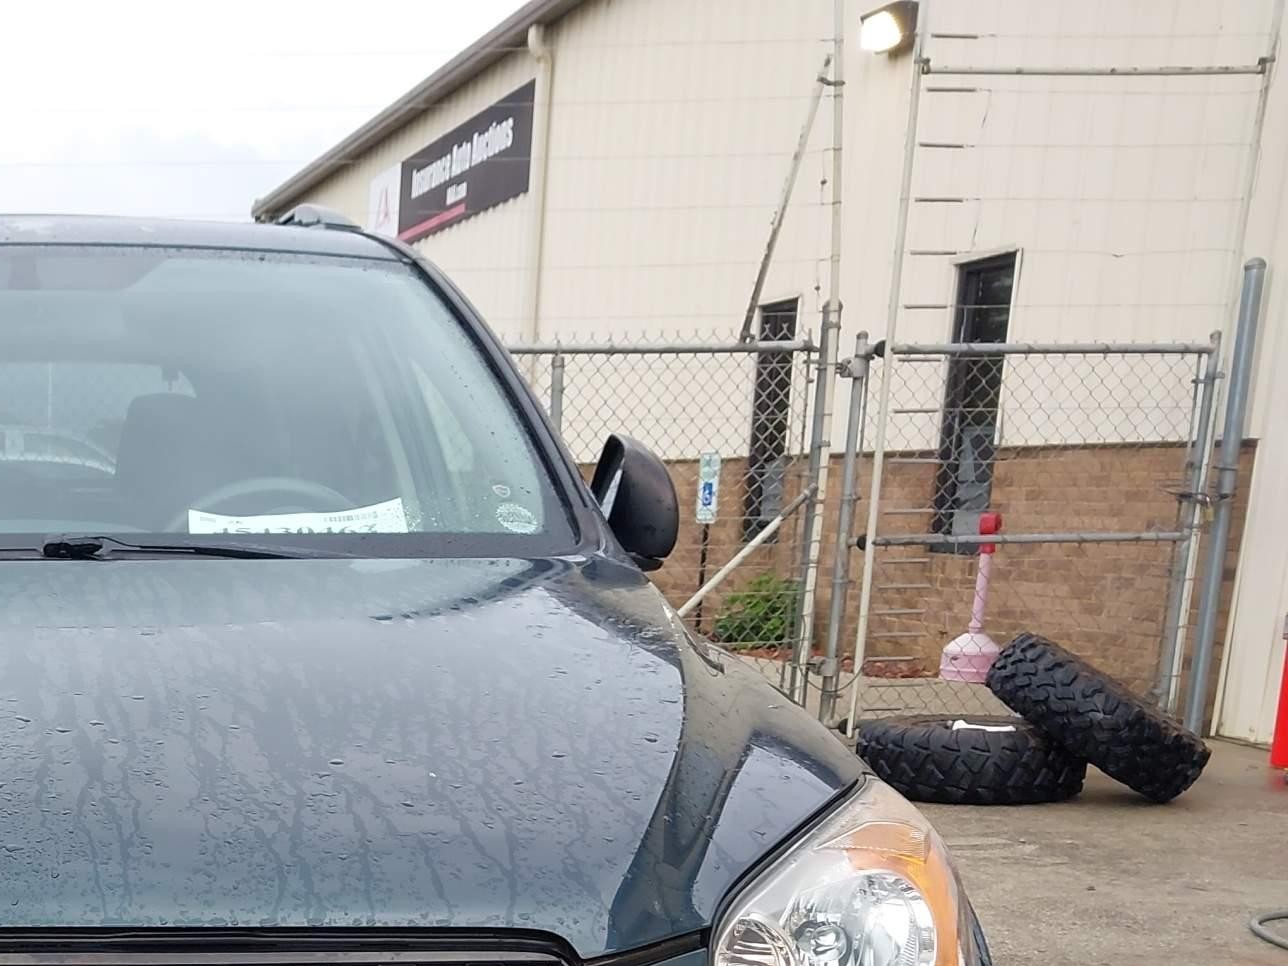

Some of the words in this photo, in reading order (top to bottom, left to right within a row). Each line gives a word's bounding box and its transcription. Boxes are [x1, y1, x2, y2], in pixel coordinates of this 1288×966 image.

[411, 153, 451, 199] Insurance
[451, 141, 471, 178] Auto
[471, 117, 514, 167] Auctions
